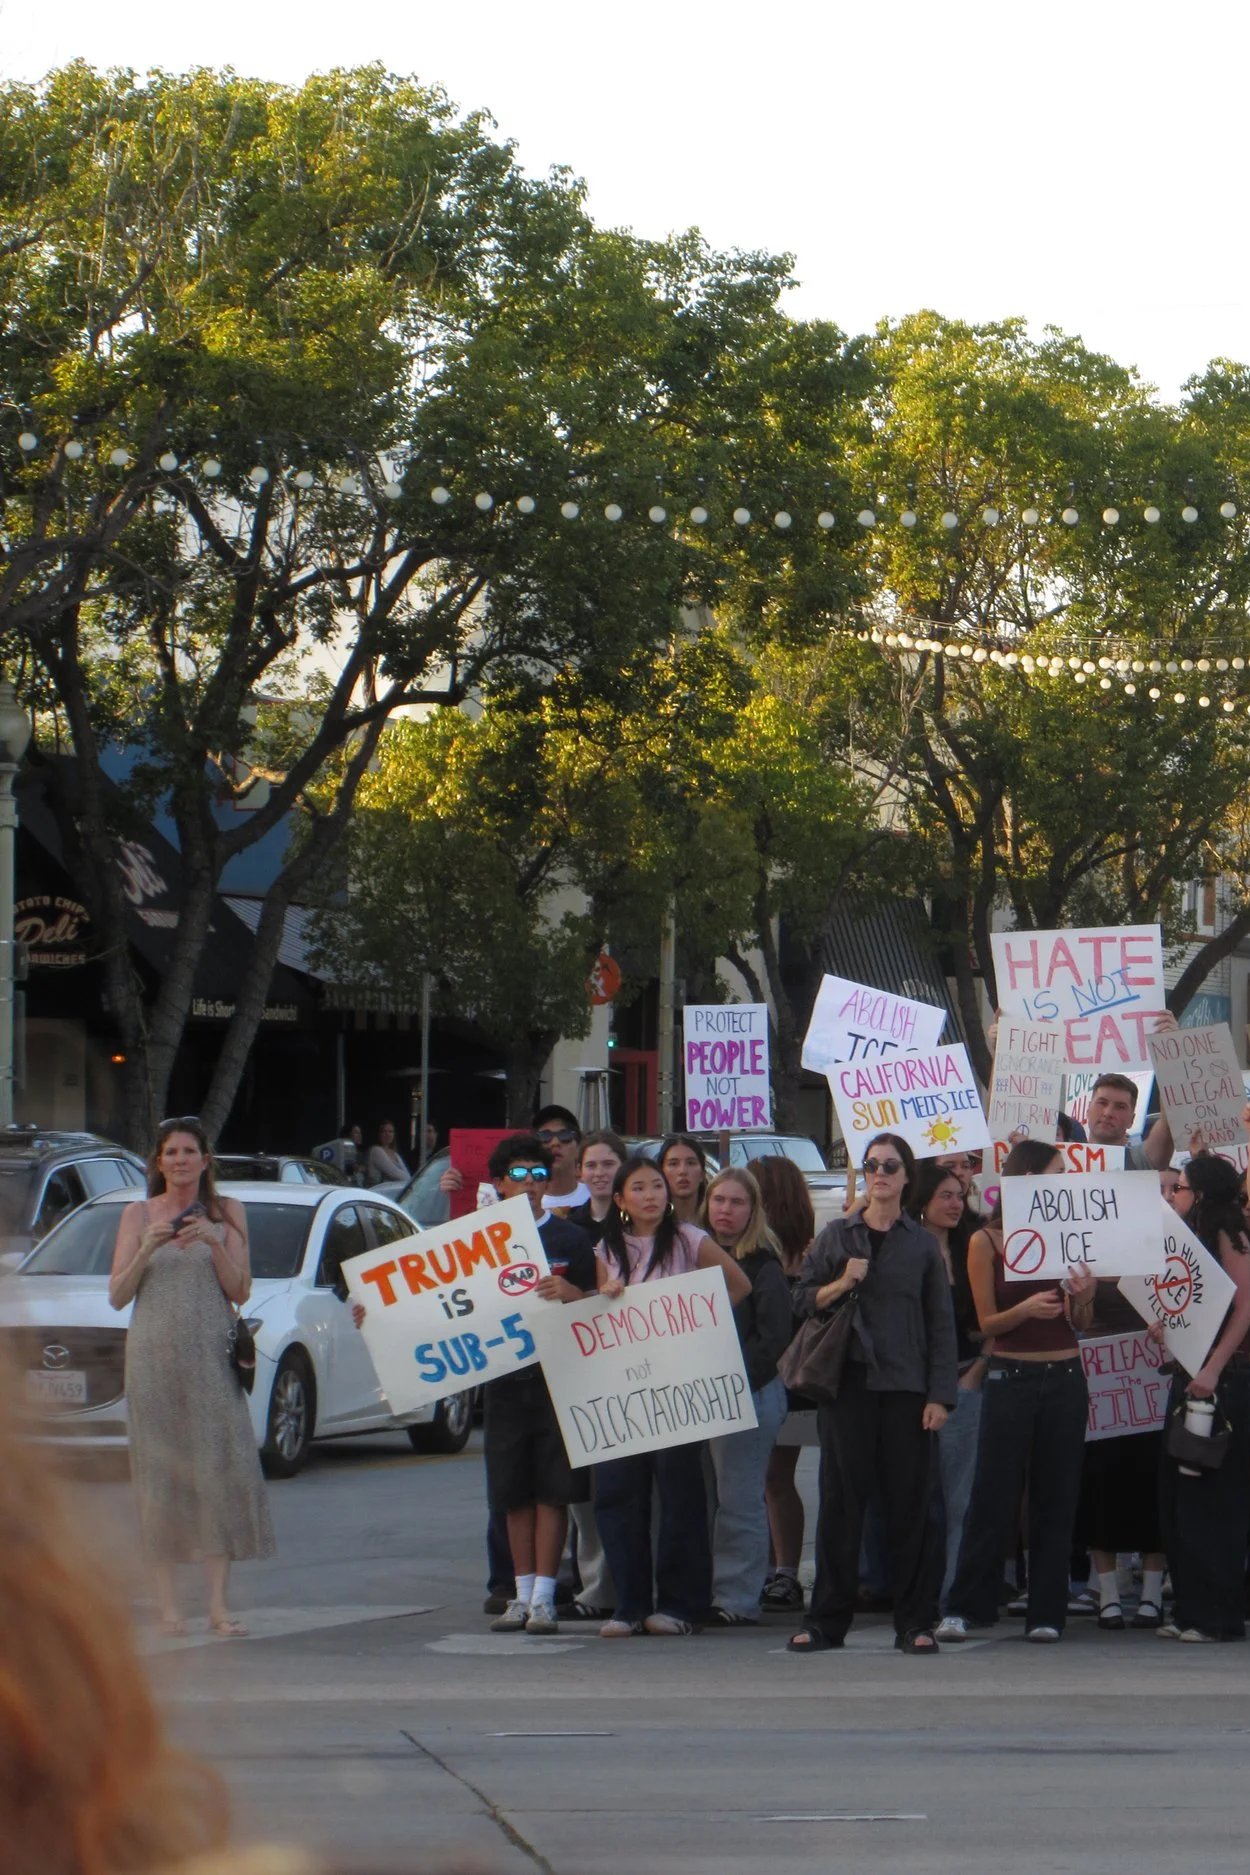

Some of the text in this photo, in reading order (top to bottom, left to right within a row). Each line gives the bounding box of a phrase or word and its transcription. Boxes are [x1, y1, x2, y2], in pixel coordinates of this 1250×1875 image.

[15, 912, 79, 945] Deli
[1005, 936, 1156, 990] HATE
[192, 998, 206, 1017] Life
[207, 1001, 215, 1017] is
[1023, 991, 1059, 1022] IS
[1071, 967, 1138, 1012] NOT
[695, 1011, 757, 1033] PROTECT
[839, 988, 919, 1043] ABOLISH
[687, 1039, 766, 1076] PEOPLE
[1009, 1028, 1060, 1054] FIGHT
[1151, 1032, 1221, 1061] NO ONE
[840, 1054, 964, 1099] CALIFORNIA
[1009, 1074, 1041, 1096] NOT
[1183, 1059, 1204, 1079] IS
[706, 1076, 741, 1096] NOT
[1163, 1076, 1241, 1106] ILLEGAL
[688, 1096, 769, 1130] POWER
[900, 1091, 949, 1120] MELTS
[949, 1089, 979, 1111] ICE
[1195, 1103, 1218, 1119] ON
[1184, 1117, 1240, 1136] STOLEN
[1200, 1129, 1236, 1145] LAND
[1029, 1188, 1118, 1223] ABOLISH
[361, 1221, 513, 1307] TRUMP
[1060, 1231, 1097, 1264] ICE
[1162, 1268, 1187, 1306] ICE
[1181, 1243, 1204, 1304] HUMAN
[571, 1292, 718, 1357] DEMOCRACY
[1148, 1294, 1191, 1330] ILLEGAL
[414, 1312, 536, 1383] SUB-5
[625, 1358, 652, 1383] not
[1115, 1375, 1142, 1388] The
[569, 1373, 745, 1453] DICKTATORSHIP
